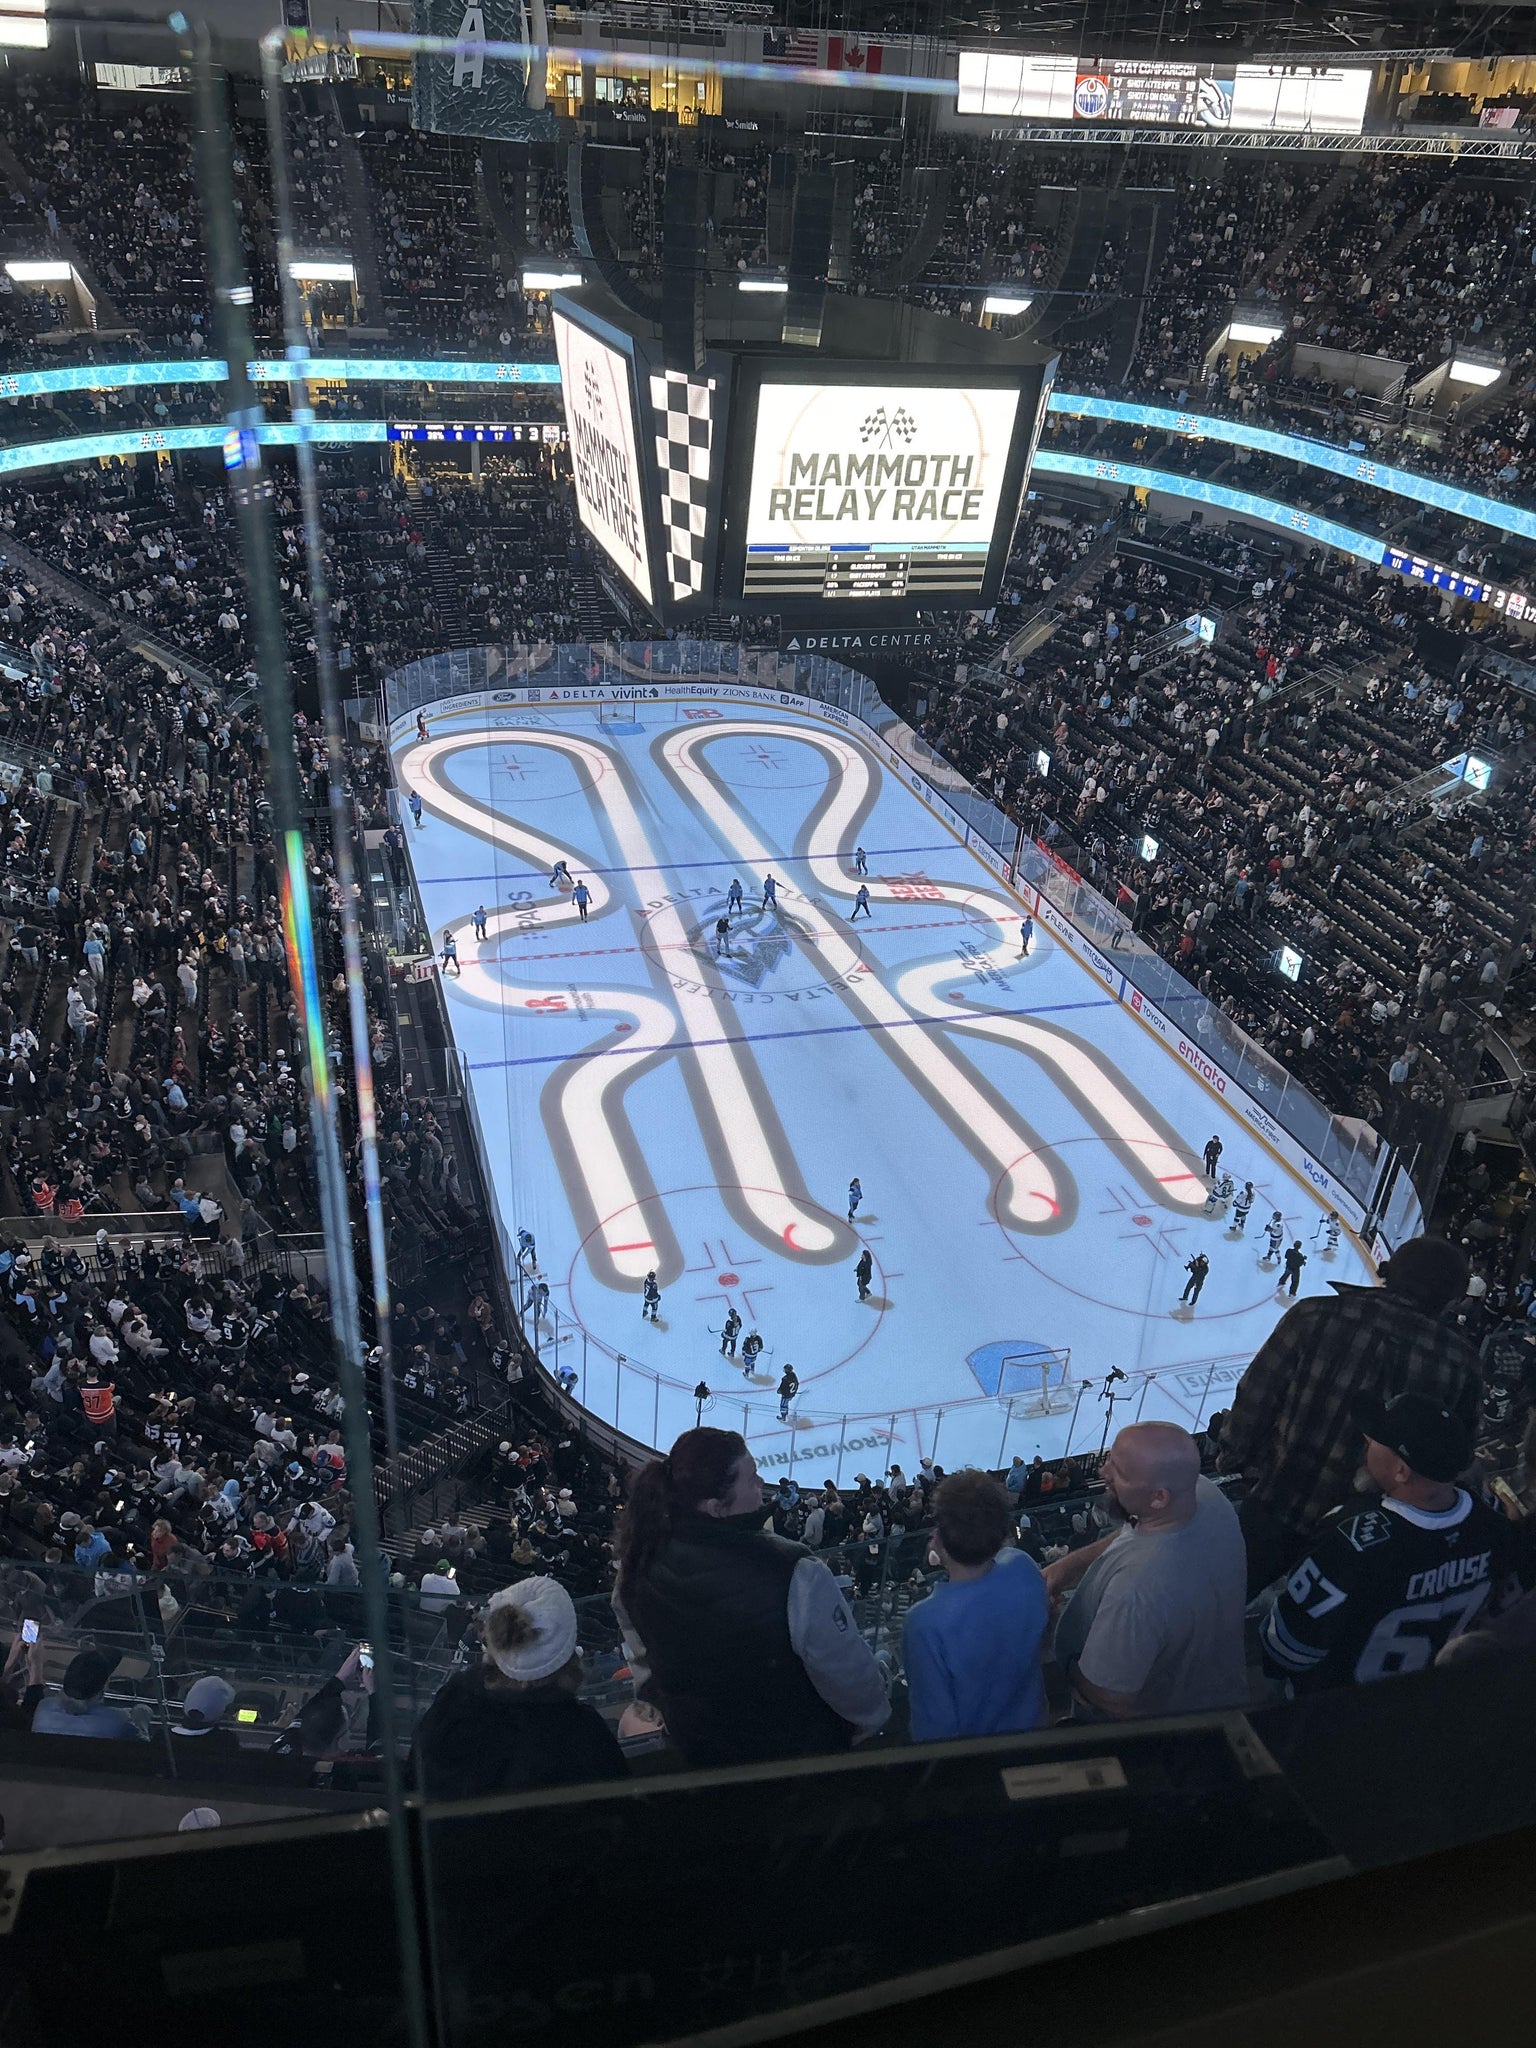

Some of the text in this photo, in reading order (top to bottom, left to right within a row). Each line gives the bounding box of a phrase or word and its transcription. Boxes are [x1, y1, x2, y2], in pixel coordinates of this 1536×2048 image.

[574, 409, 631, 505] MAMMOTH
[789, 453, 975, 487] MAMMOTH
[576, 453, 642, 563] RELAY RACE
[768, 489, 984, 521] RELAY RACE
[806, 633, 933, 649] DELTA CENTER
[443, 699, 479, 712] INGREDIENTS
[563, 690, 605, 699] DELTA
[611, 687, 648, 699] vivint
[664, 686, 719, 696] HealthEquity
[723, 688, 776, 701] ZIONS BANK
[819, 703, 849, 719] AMERICAN
[823, 711, 849, 727] EXPRESS
[508, 890, 545, 933] PACS
[648, 886, 722, 909] DELTA
[1050, 913, 1074, 943] FILEVINE
[672, 974, 864, 1004] DELTA CENTER
[1142, 1003, 1167, 1034] TOYOTA
[1178, 1040, 1227, 1095] entrata
[83, 1395, 100, 1409] 97
[788, 1382, 797, 1394] 2
[756, 1432, 892, 1469] CROWDSTRIK
[1287, 1556, 1348, 1619] 67
[1406, 1551, 1492, 1601] CROUSE
[1355, 1581, 1492, 1685] 67
